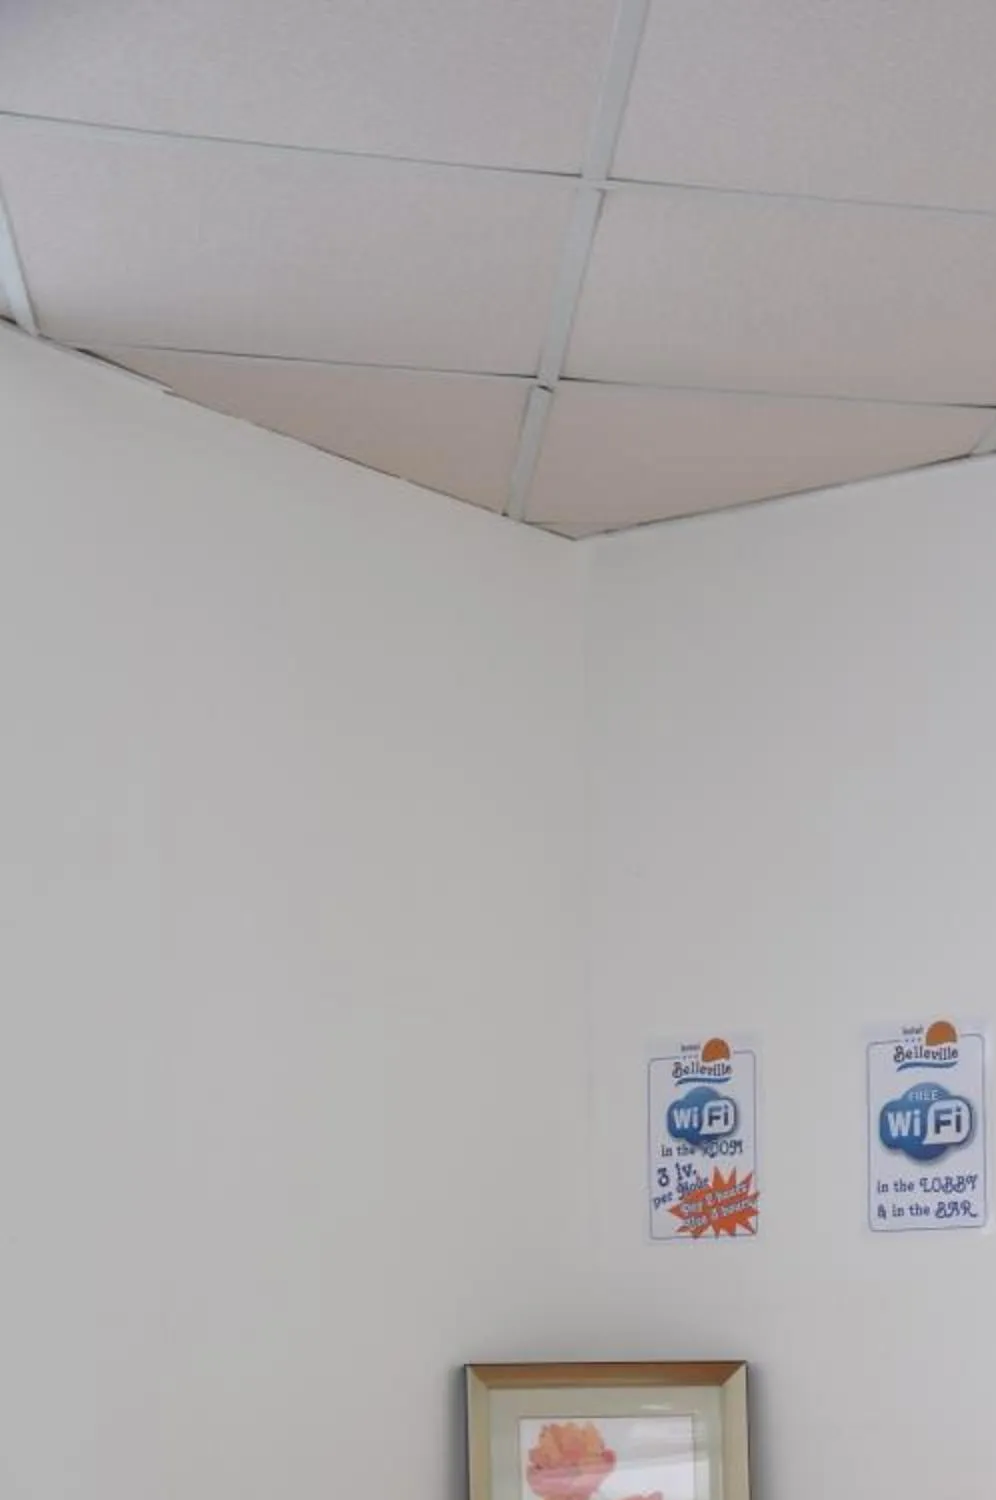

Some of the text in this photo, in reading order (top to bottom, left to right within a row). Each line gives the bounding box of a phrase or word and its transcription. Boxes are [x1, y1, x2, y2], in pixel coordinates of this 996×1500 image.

[893, 1044, 958, 1062] Belleville
[672, 1060, 733, 1079] Belleville
[657, 1167, 669, 1187] 3
[877, 1180, 889, 1194] in
[893, 1177, 915, 1193] the
[892, 1204, 905, 1218] in
[909, 1202, 931, 1217] the
